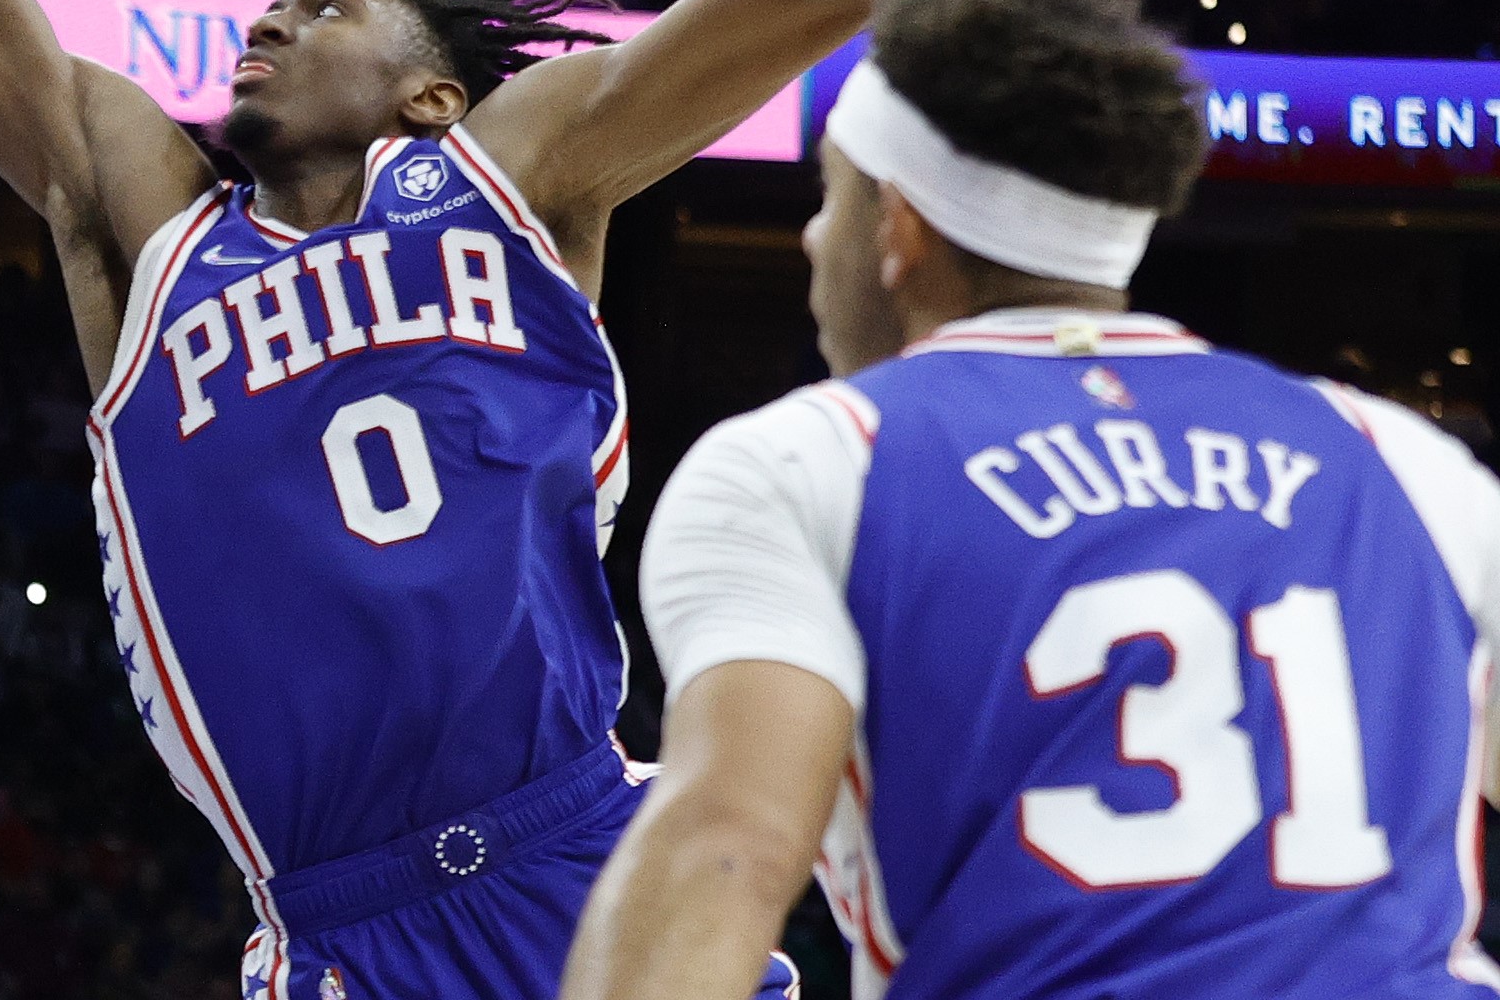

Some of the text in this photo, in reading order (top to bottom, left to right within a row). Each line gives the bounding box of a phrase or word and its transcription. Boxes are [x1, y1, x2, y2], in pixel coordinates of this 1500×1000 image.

[386, 190, 481, 226] crypto.com
[161, 228, 528, 442] PHILA
[320, 393, 444, 549] 0
[964, 419, 1320, 539] CURRY
[1017, 568, 1393, 893] 31
